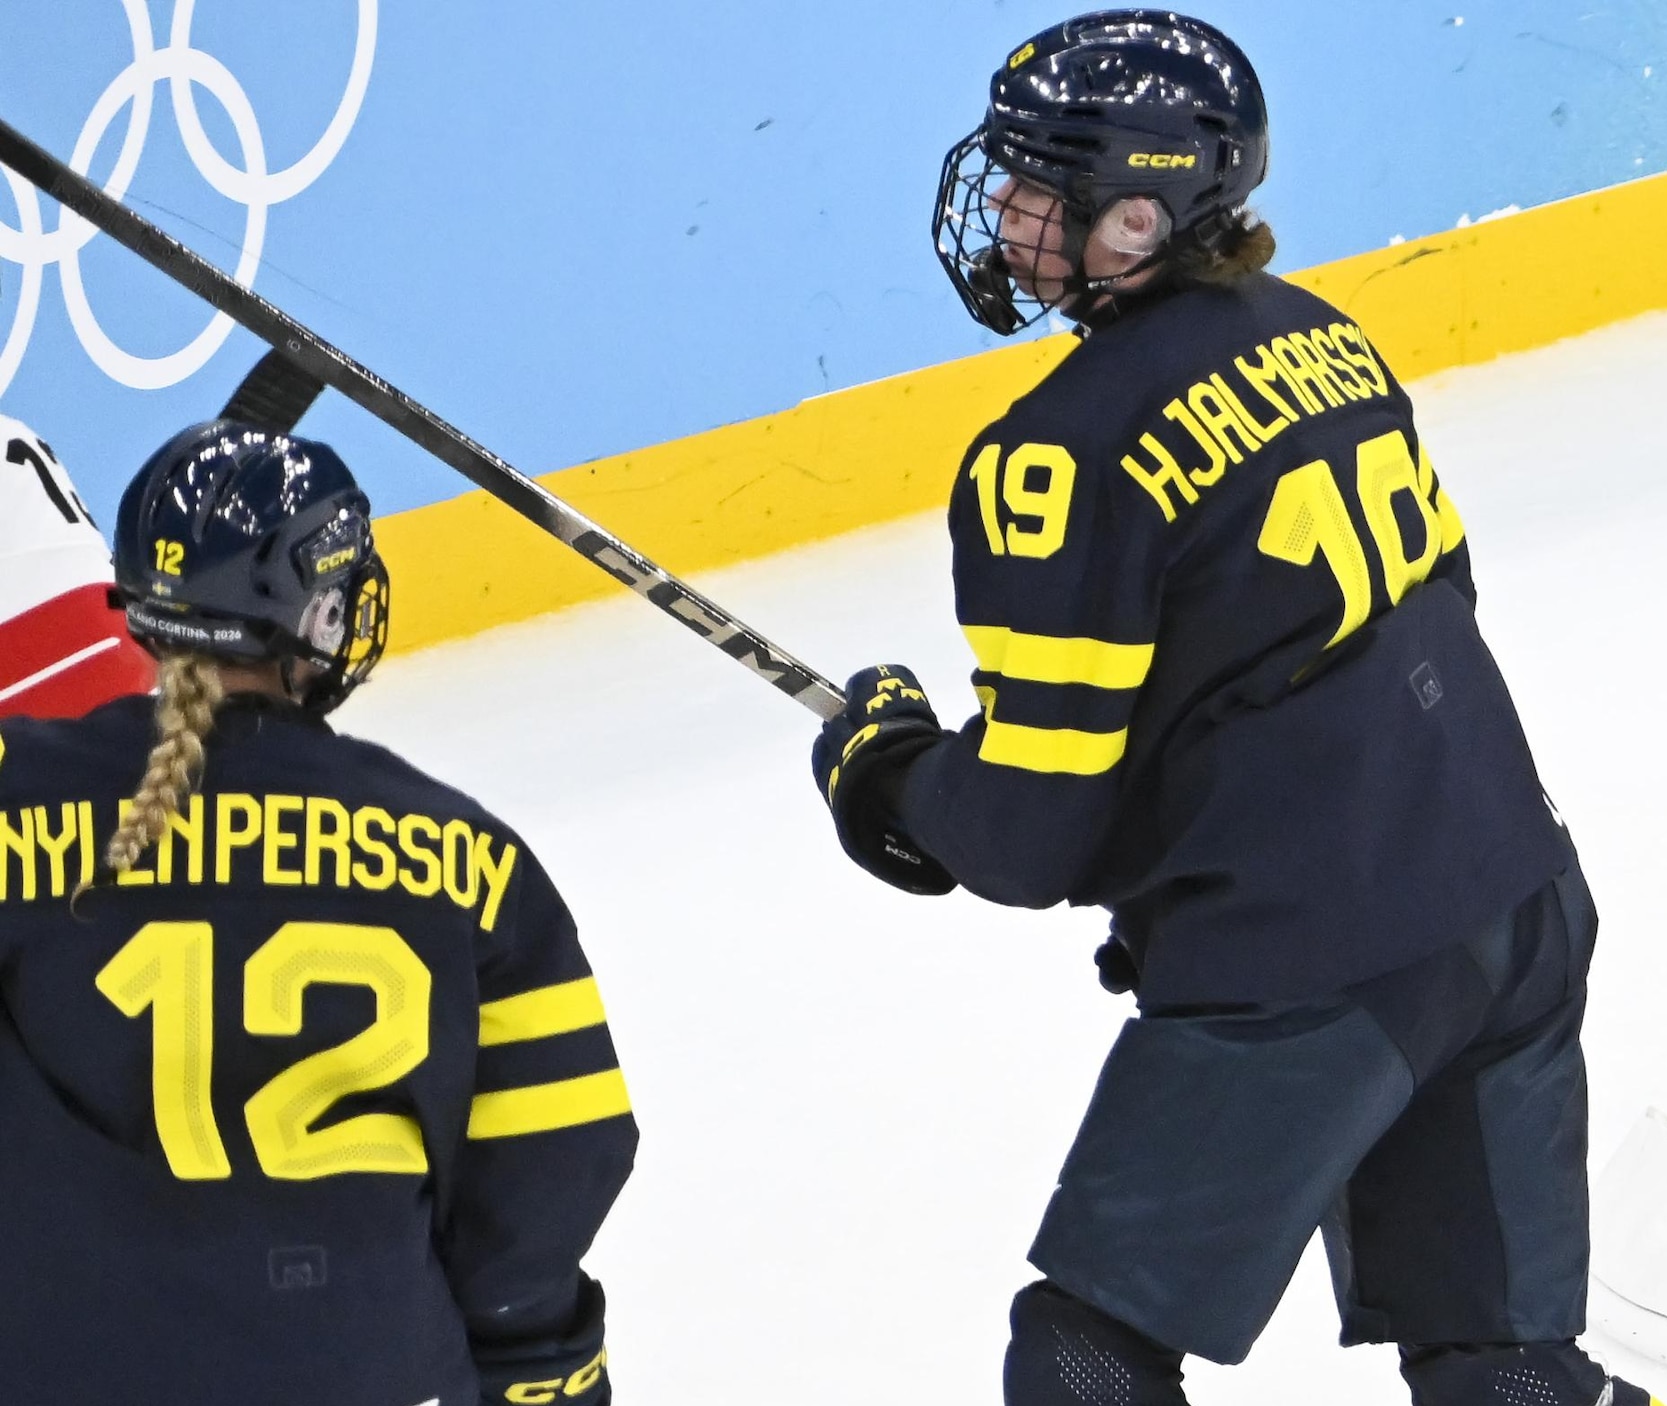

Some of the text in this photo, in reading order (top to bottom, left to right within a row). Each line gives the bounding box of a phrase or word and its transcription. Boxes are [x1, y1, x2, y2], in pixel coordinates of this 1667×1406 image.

[1127, 152, 1196, 169] CCM
[1119, 322, 1389, 524] HJALMARSS
[969, 442, 1078, 560] 19
[154, 537, 185, 576] 12
[213, 628, 242, 642] 2026
[572, 529, 822, 698] CCM
[95, 919, 431, 1182] 12
[504, 1343, 608, 1406] CC
